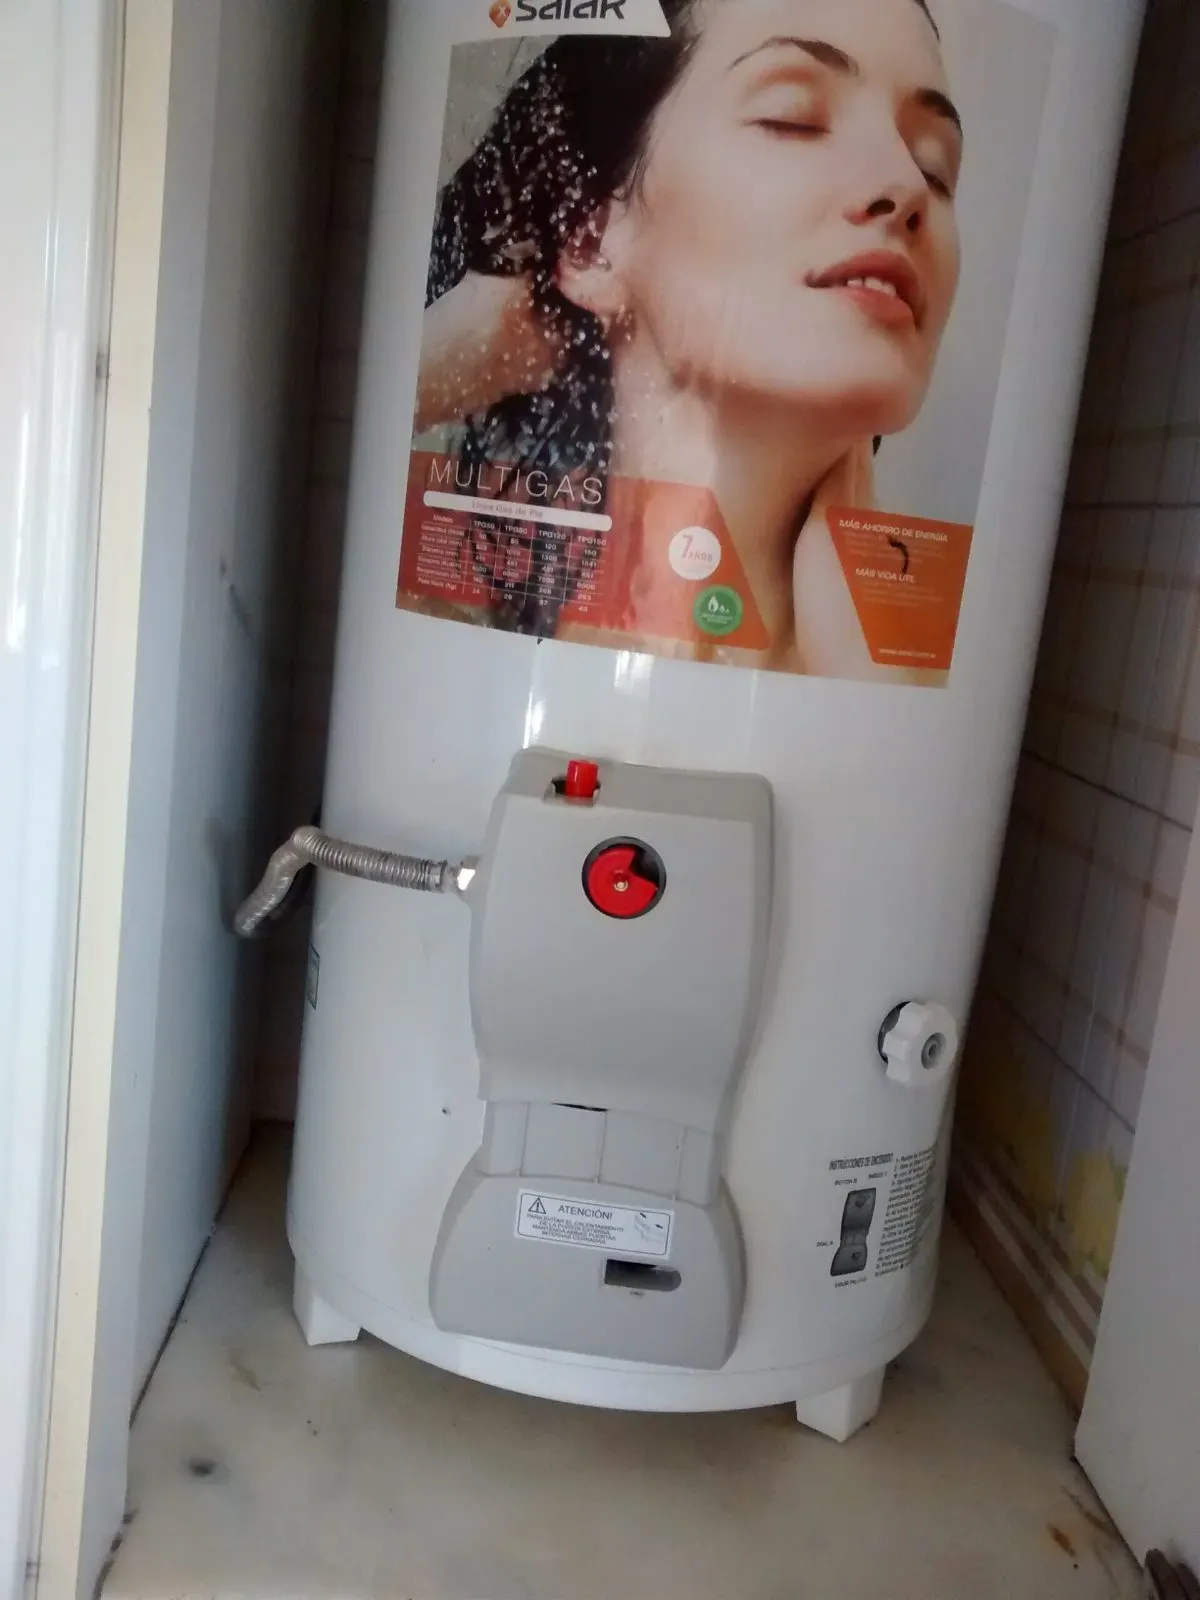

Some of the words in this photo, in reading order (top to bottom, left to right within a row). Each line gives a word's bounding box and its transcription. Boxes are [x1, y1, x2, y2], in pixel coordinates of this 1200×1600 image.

[430, 458, 603, 505] MULTIGAS
[839, 518, 860, 530] MÁS
[862, 522, 901, 535] AHORRO
[902, 527, 914, 537] DE
[682, 534, 693, 559] 7
[877, 570, 897, 581] VIDA
[557, 1203, 613, 1221] ATENCIÓN!
